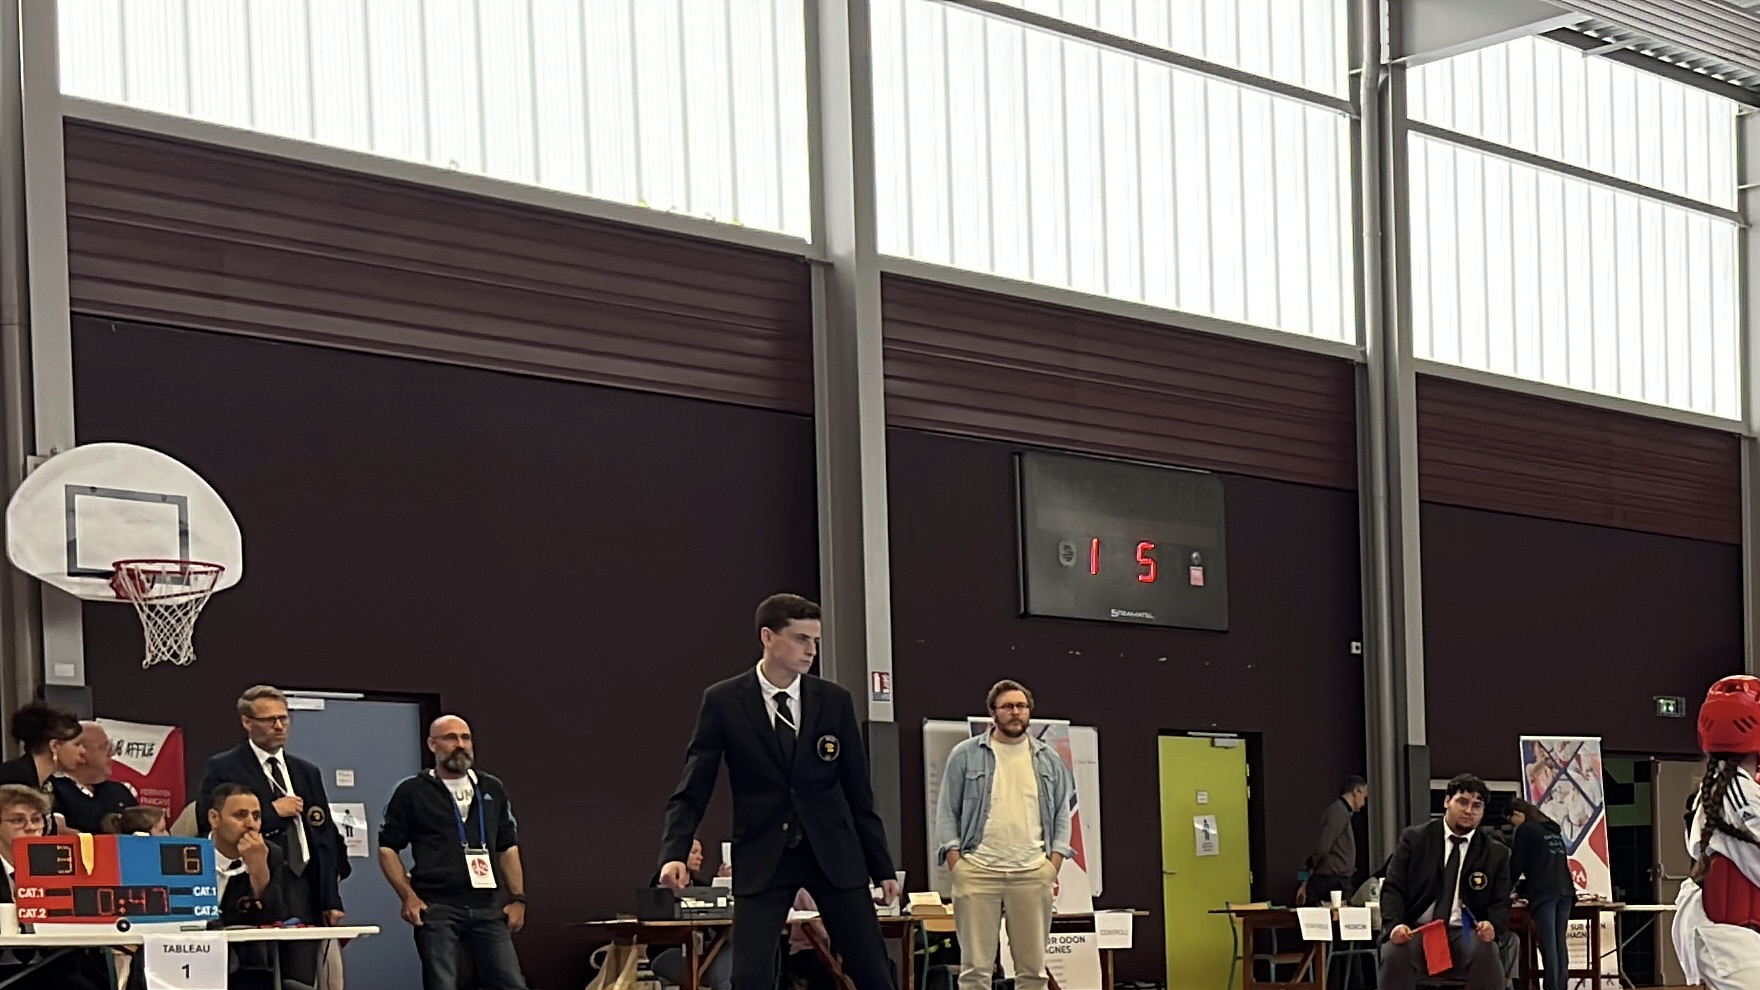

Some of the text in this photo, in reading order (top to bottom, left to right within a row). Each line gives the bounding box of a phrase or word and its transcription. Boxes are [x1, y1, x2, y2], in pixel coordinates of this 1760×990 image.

[56, 845, 73, 874] 3
[183, 846, 200, 873] 6
[17, 887, 45, 898] CAT.1
[193, 886, 217, 897] CAT.1
[18, 907, 47, 919] CAT.2
[194, 905, 219, 917] CAT.2
[1059, 935, 1086, 944] ODON
[163, 943, 210, 954] TABLEAU
[181, 963, 190, 979] 1
